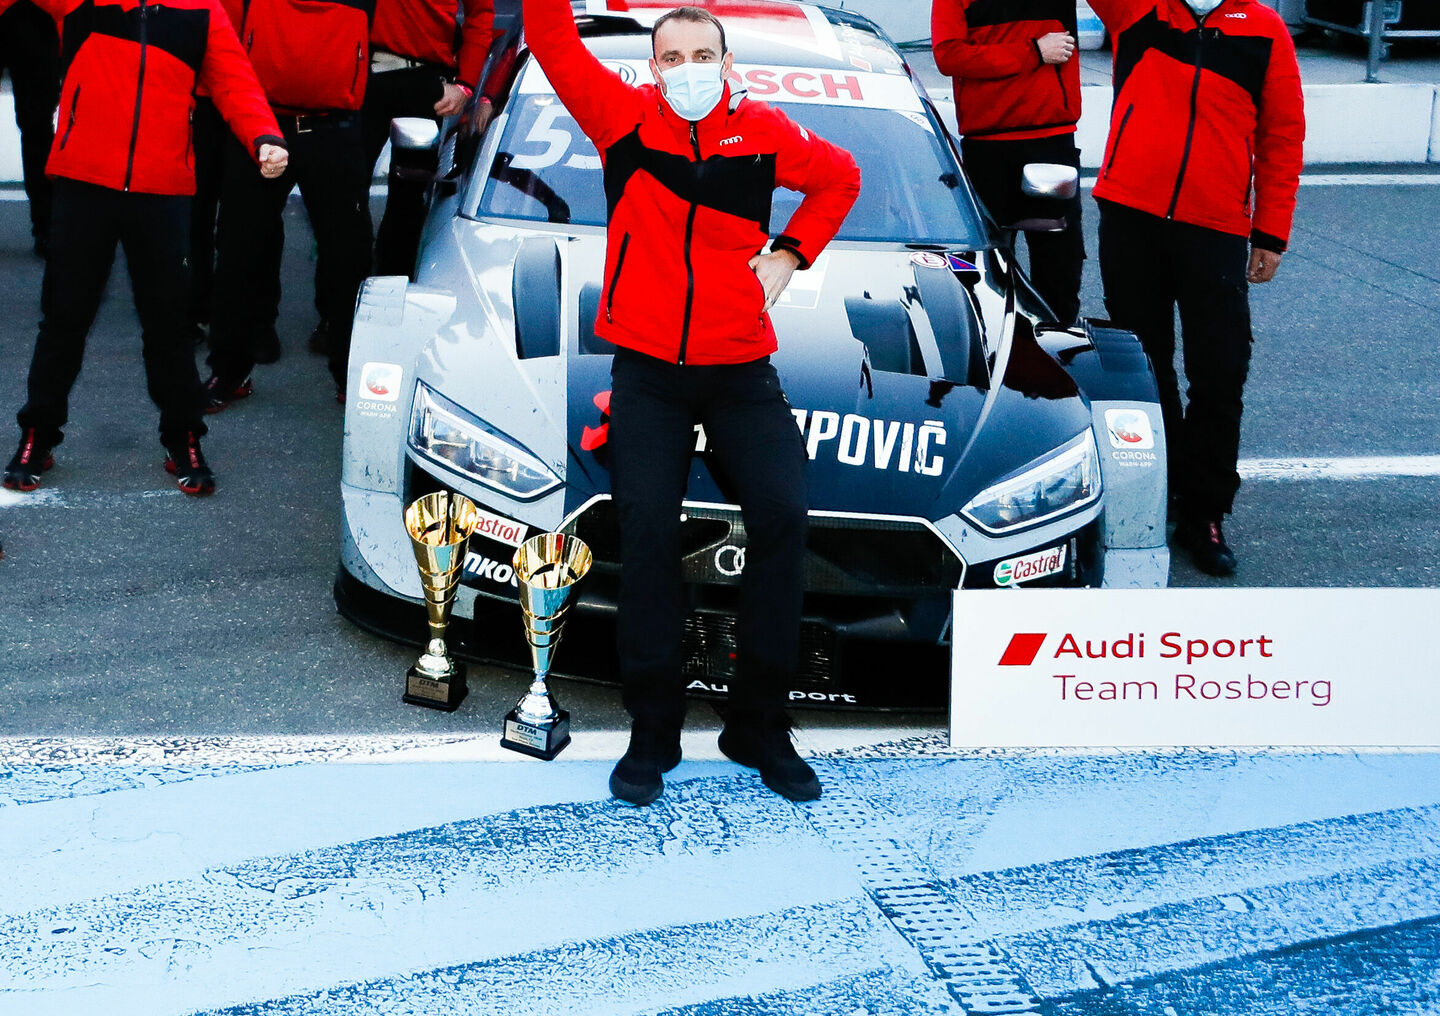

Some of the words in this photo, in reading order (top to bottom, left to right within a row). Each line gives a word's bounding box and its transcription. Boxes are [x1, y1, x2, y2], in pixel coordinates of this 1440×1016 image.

[727, 69, 864, 101] SCH
[508, 104, 604, 170] 5
[356, 401, 398, 413] CORONA
[1112, 451, 1157, 460] CORONA
[475, 514, 521, 544] astrol
[1013, 546, 1063, 580] Castrol
[1053, 632, 1145, 659] Audi
[1159, 632, 1273, 664] Sport
[686, 679, 729, 693] Au
[788, 690, 857, 703] port
[1052, 674, 1157, 701] Team
[1174, 674, 1332, 706] Rosberg
[517, 724, 537, 736] DTM
